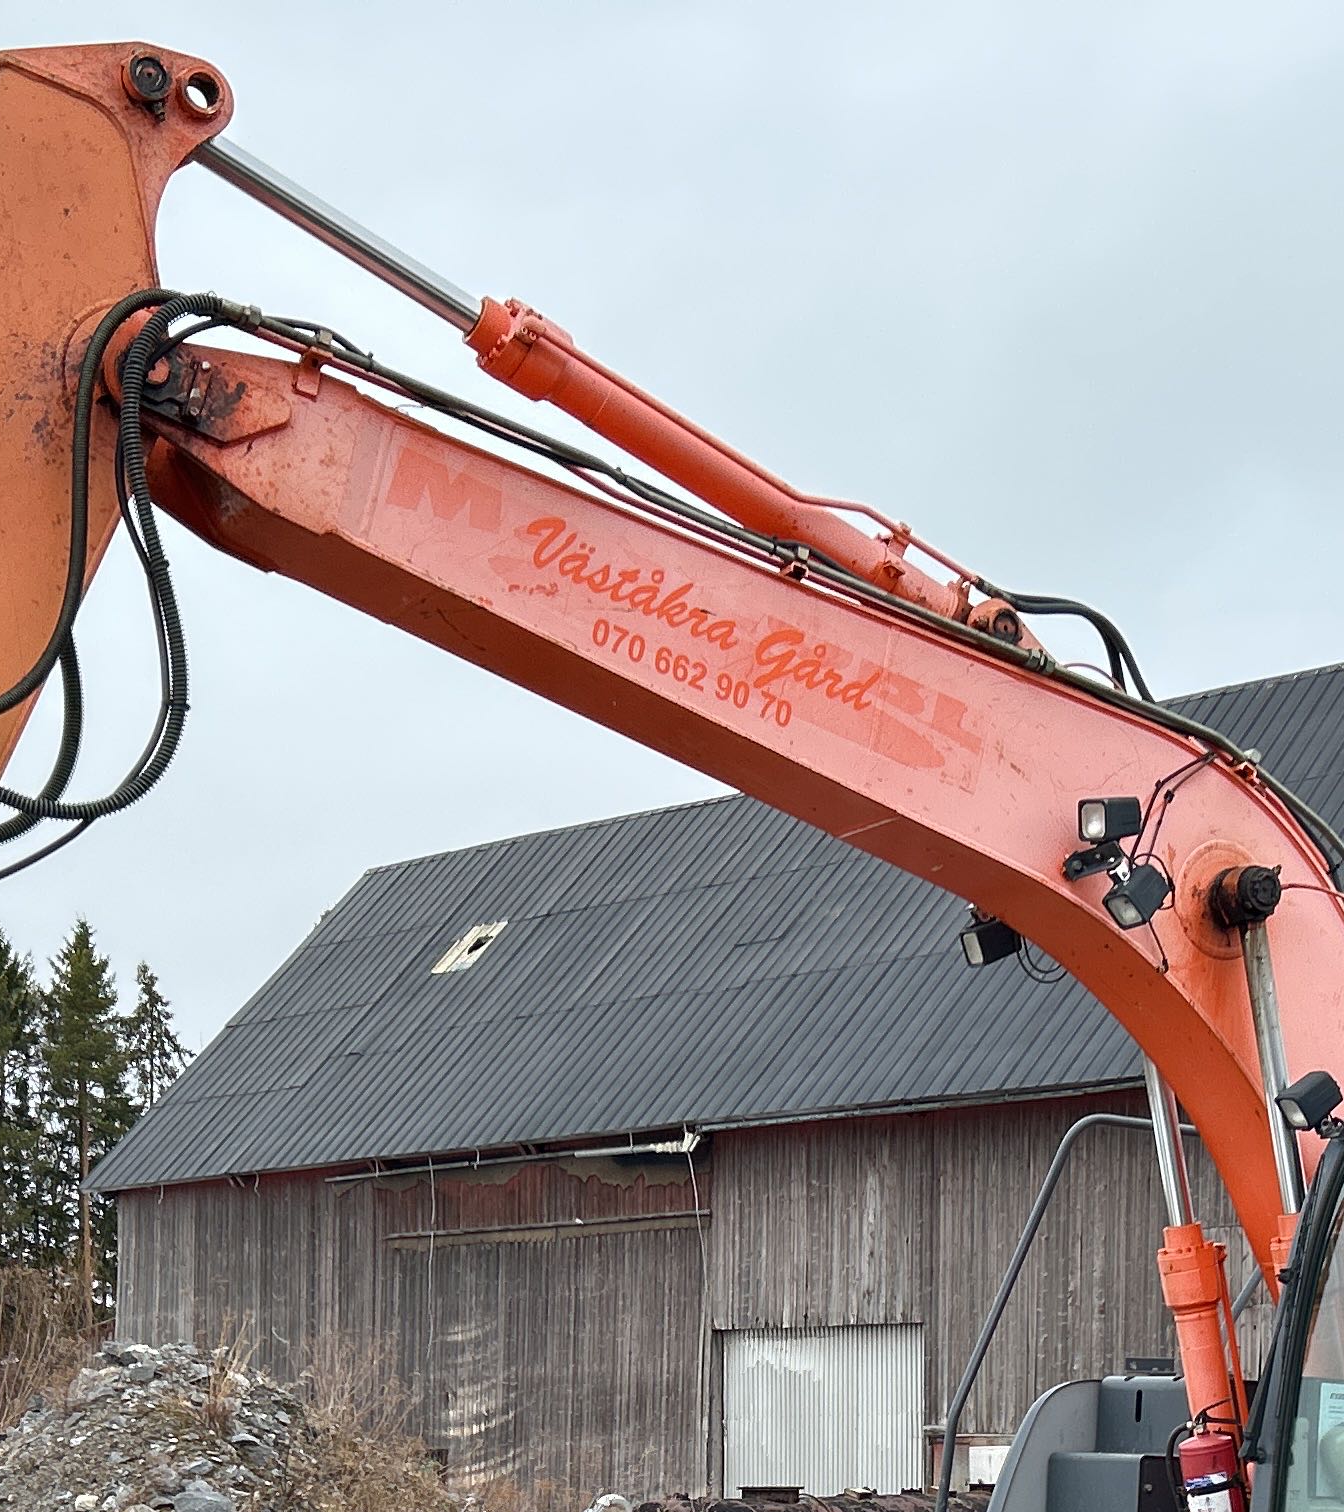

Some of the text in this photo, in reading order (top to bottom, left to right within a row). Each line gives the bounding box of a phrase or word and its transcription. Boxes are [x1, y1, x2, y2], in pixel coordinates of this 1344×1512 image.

[526, 515, 872, 711] Väståkra Gård
[592, 618, 793, 728] 070 662 90 70
